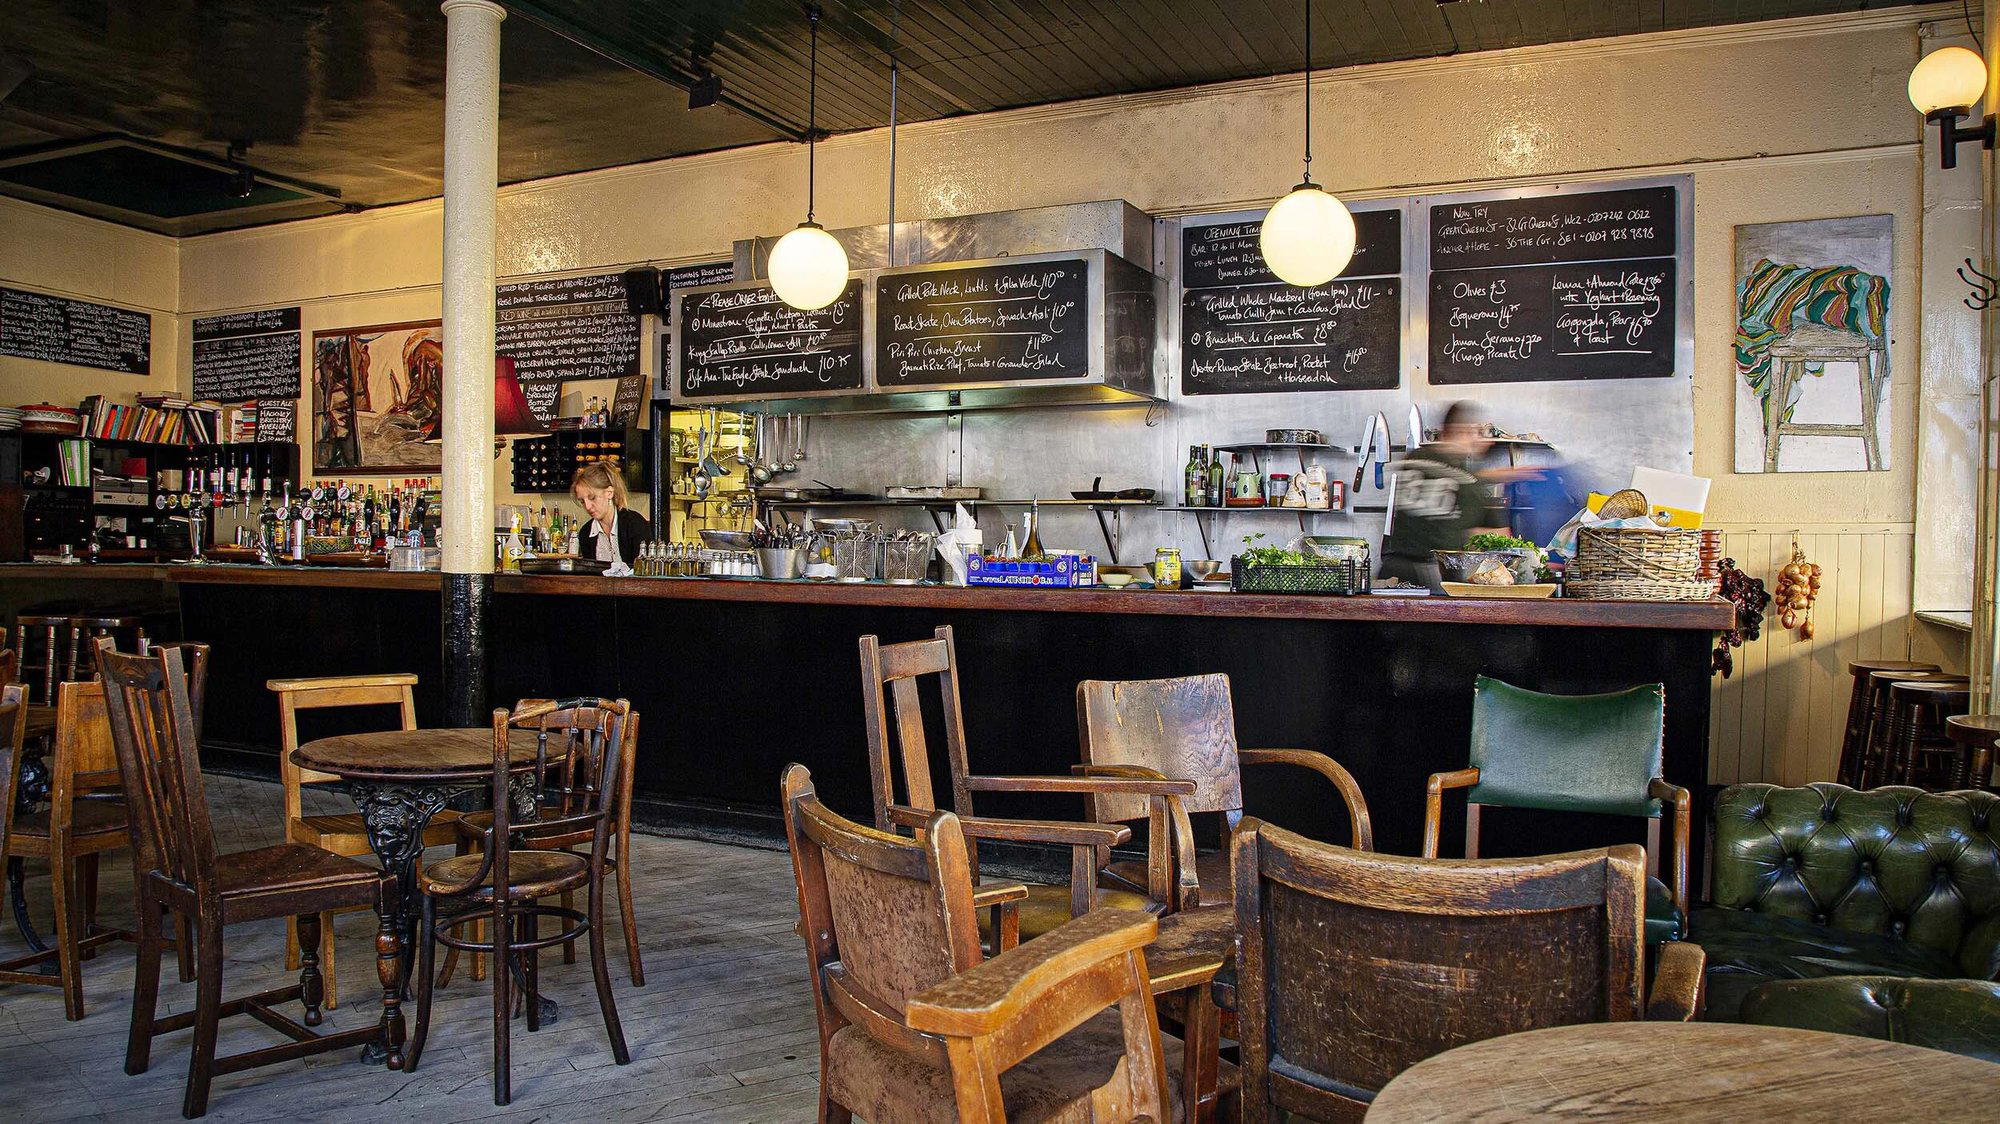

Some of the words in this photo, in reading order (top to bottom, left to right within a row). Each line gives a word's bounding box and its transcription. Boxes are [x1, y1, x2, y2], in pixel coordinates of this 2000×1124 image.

[1472, 204, 1488, 218] TRY
[1204, 226, 1240, 239] OPENING
[1438, 224, 1460, 238] GREAT
[1460, 223, 1484, 234] QUEEN
[1627, 210, 1650, 220] 0622
[1586, 231, 1606, 242] 0207
[1611, 228, 1627, 241] 928
[1630, 227, 1654, 240] 9898
[1218, 256, 1238, 264] LUNCH
[1218, 268, 1242, 280] DINNER
[1552, 274, 1584, 290] Lemon
[898, 284, 922, 302] Grilled
[965, 278, 988, 294] Lentils
[1019, 274, 1040, 288] Verde
[1454, 282, 1486, 298] Olives
[1490, 280, 1506, 304] £3
[711, 293, 734, 308] PLEASE
[1206, 296, 1238, 312] Grilled
[1241, 294, 1268, 306] Whole
[1269, 290, 1304, 304] Mackerel
[1214, 309, 1242, 320] Tomato
[1244, 306, 1264, 318] Chilli
[1329, 296, 1360, 316] Salad
[1584, 290, 1620, 310] Yoghurt
[796, 318, 818, 330] Pasta
[894, 315, 914, 331] Roast
[943, 312, 963, 327] Oven
[1450, 307, 1498, 328] Boquerones
[1205, 331, 1247, 348] Bruschetta
[1248, 331, 1260, 342] di
[1480, 330, 1520, 348] Serrano
[1589, 330, 1614, 344] Toast
[887, 342, 904, 358] Piri
[906, 342, 920, 358] Piri
[923, 342, 954, 356] Chicken
[954, 340, 982, 356] Breast
[771, 360, 814, 380] Sandwich
[1032, 353, 1065, 370] Salad
[1238, 357, 1262, 372] Steak
[1302, 354, 1330, 368] Rocket
[528, 384, 557, 392] HACKNEY
